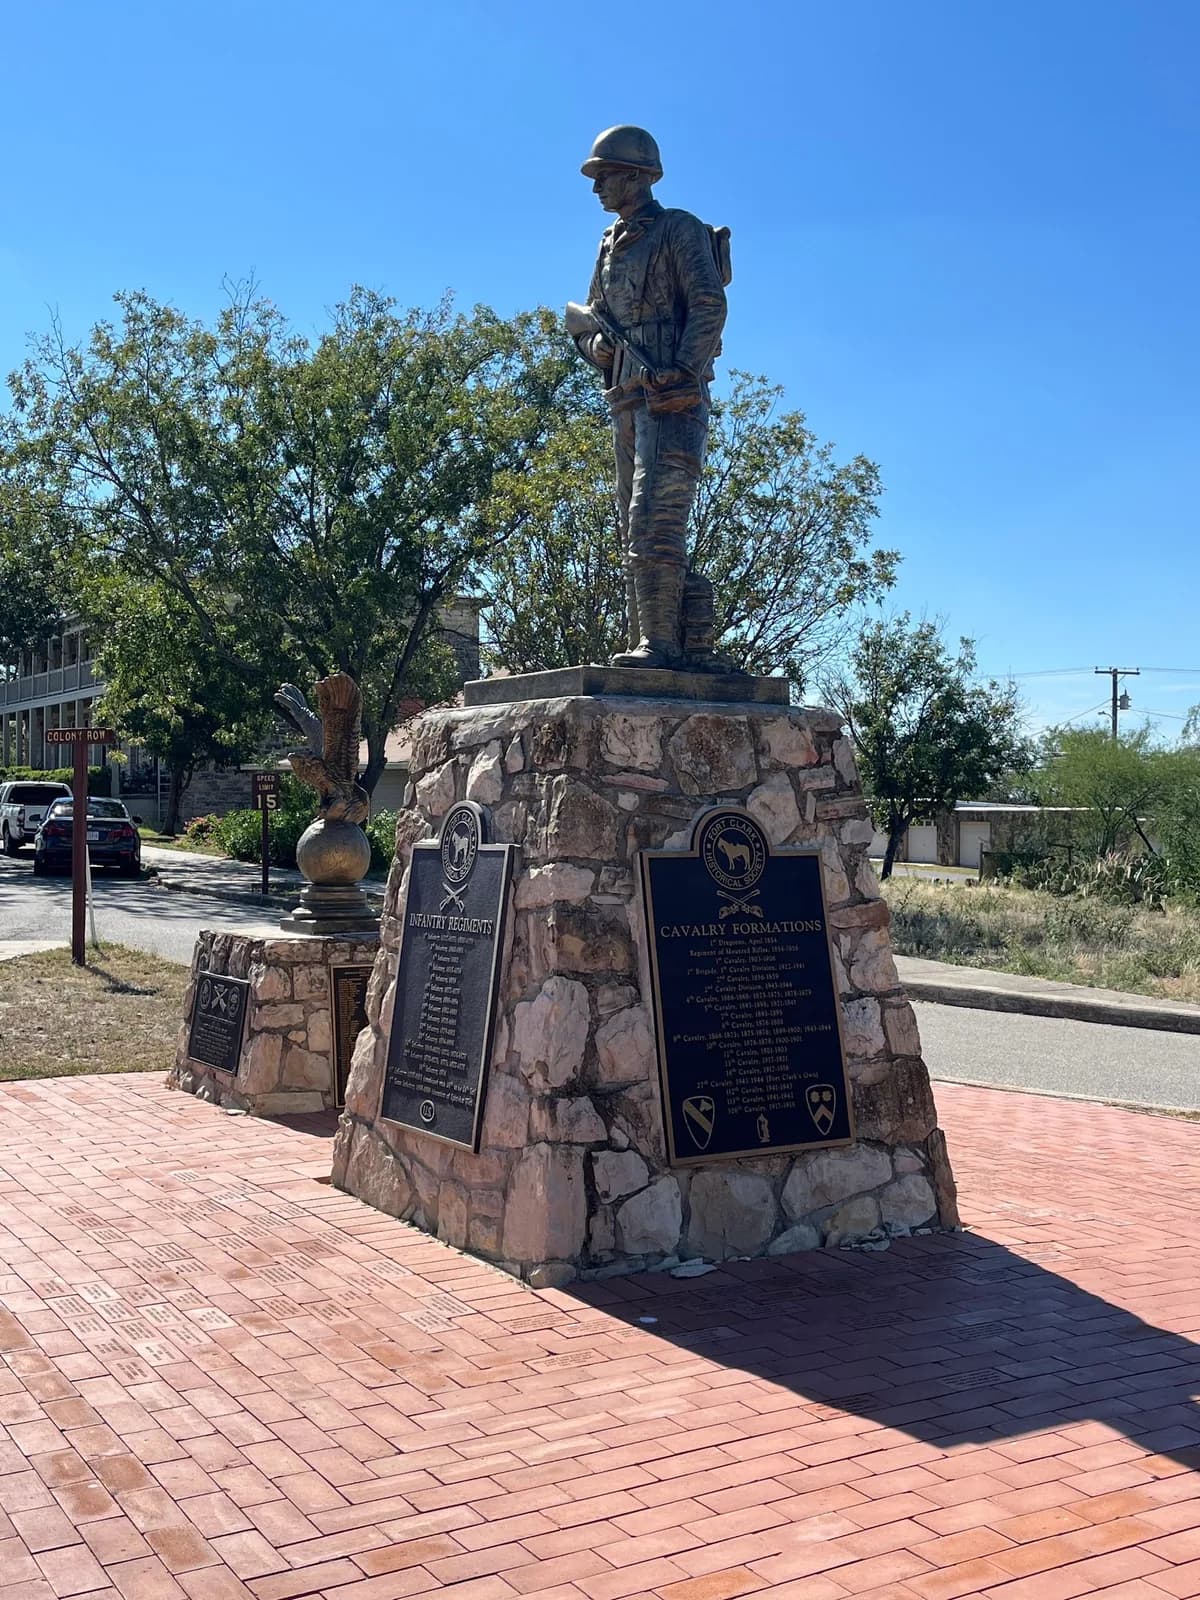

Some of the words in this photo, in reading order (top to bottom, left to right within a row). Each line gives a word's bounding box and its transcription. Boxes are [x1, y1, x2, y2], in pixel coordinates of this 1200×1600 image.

[47, 730, 83, 742] COLONY
[87, 730, 106, 742] ROW
[258, 783, 274, 791] LIMIT
[256, 794, 277, 809] 15
[708, 820, 727, 841] FORT
[729, 819, 758, 842] CLARK
[706, 852, 744, 888] HISTORICAL
[743, 850, 763, 885] SOCIETY
[409, 913, 448, 930] INFANTRY
[448, 916, 494, 935] REGIMENTS
[660, 924, 726, 938] CAVALRY
[733, 919, 823, 935] FORMATIONS
